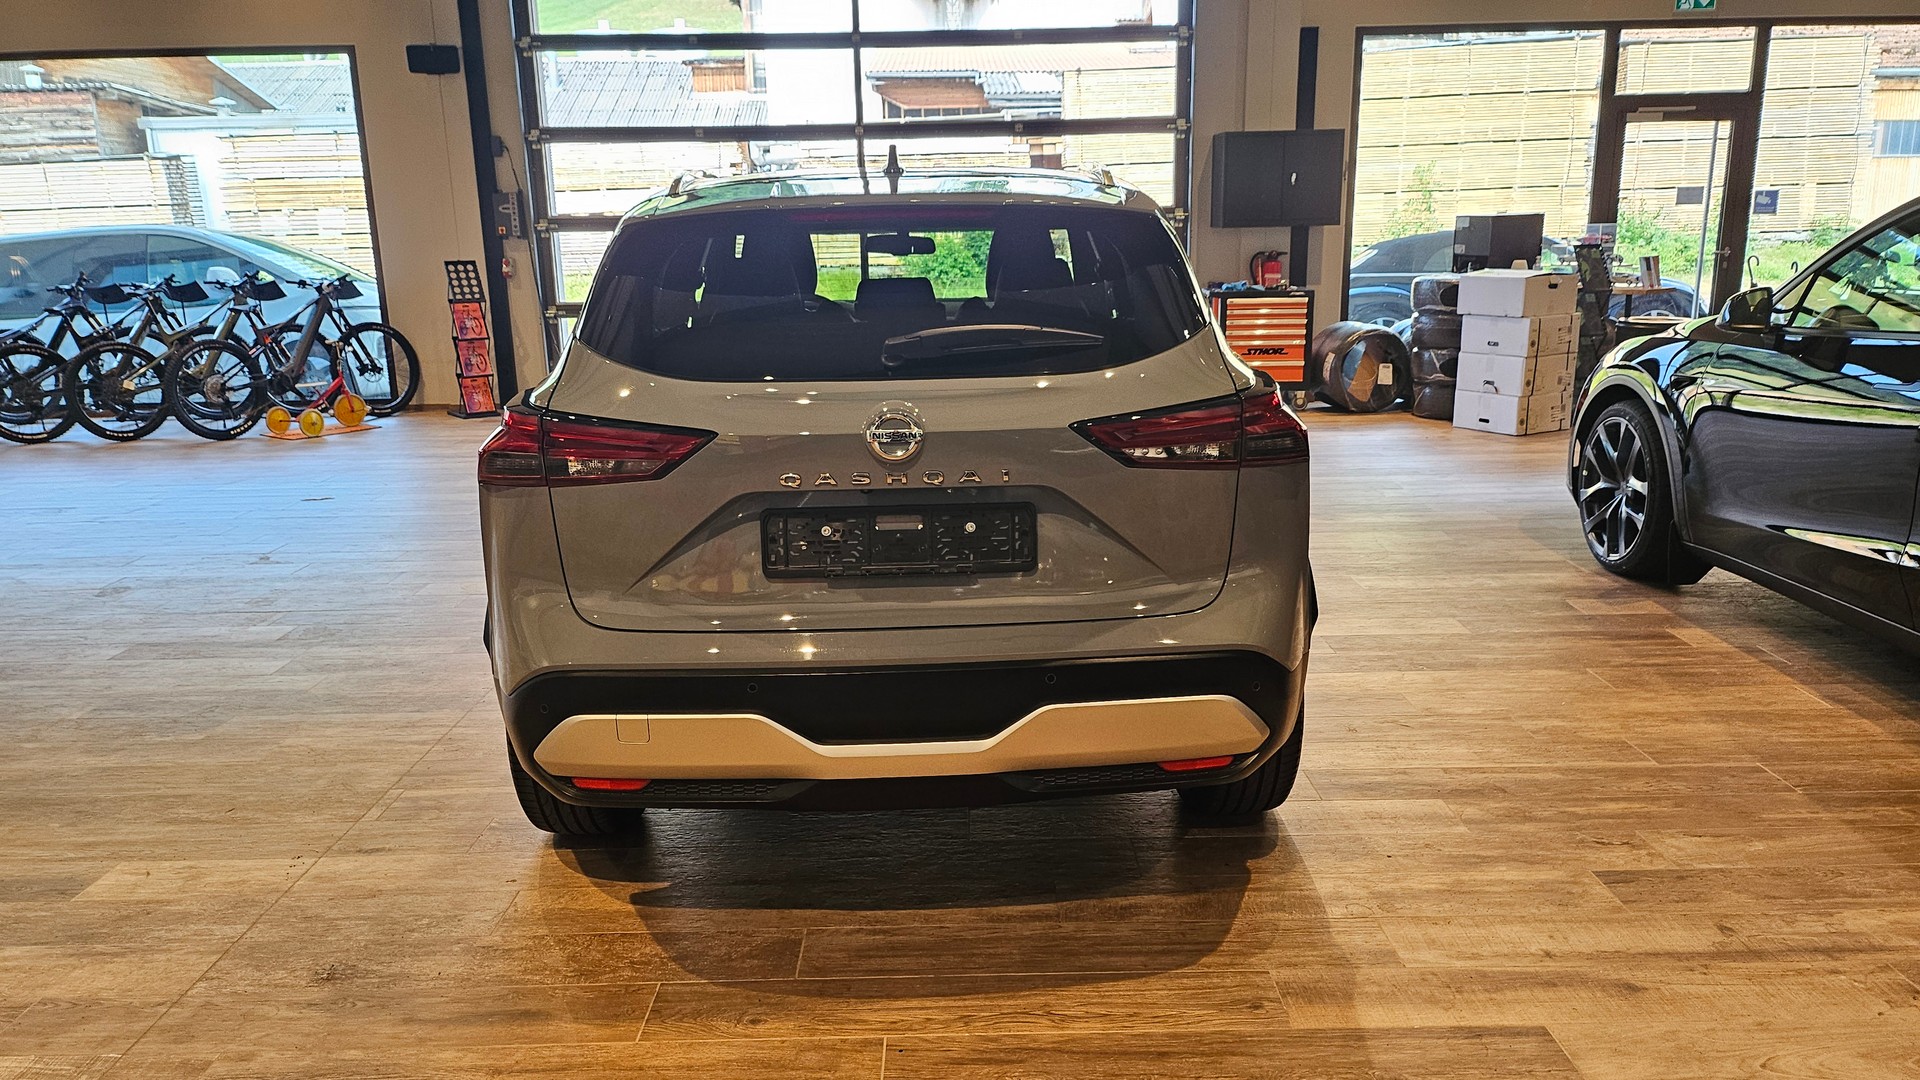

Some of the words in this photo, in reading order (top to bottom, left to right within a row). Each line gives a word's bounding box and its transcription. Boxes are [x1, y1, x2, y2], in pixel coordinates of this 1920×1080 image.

[1241, 347, 1289, 356] STHOR
[872, 431, 918, 441] NISSAN
[778, 468, 1010, 489] QASHQAI
